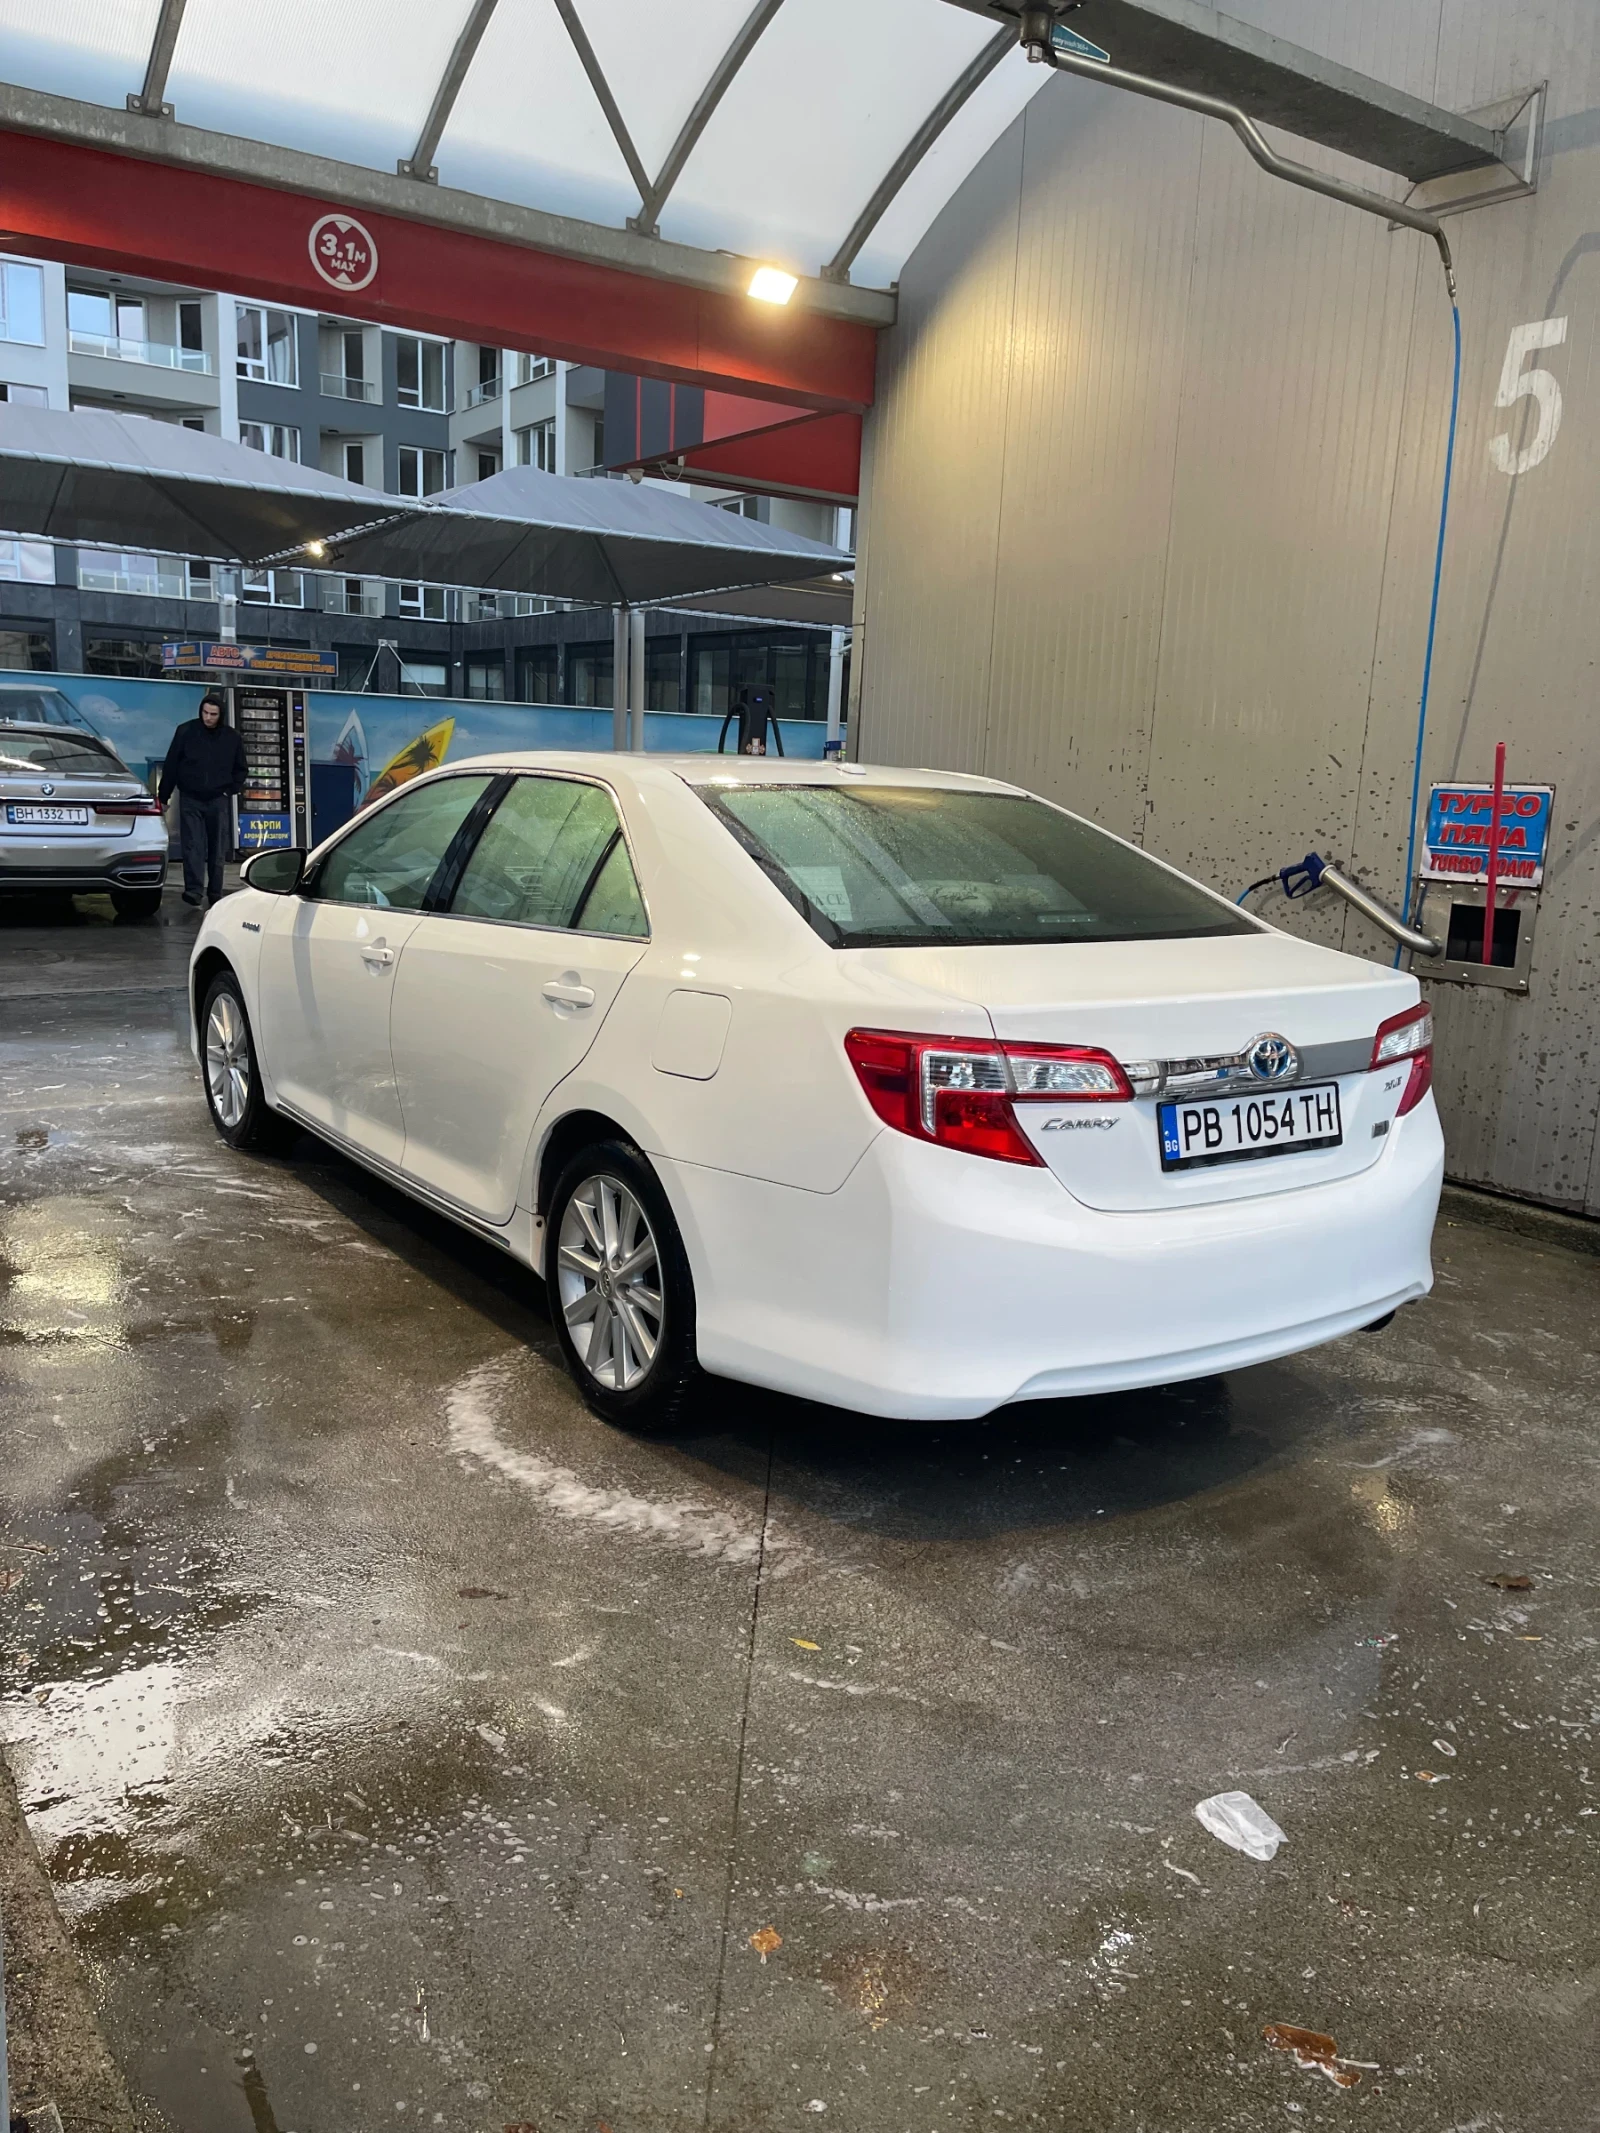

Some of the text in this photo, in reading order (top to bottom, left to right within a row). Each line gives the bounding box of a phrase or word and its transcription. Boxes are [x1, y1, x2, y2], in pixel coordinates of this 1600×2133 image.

[331, 258, 356, 273] MAX
[1489, 315, 1568, 475] 5
[15, 807, 83, 821] BH 1332 TT
[1438, 793, 1541, 817] ТУРБО
[250, 820, 282, 830] КЪРПИ
[1430, 853, 1483, 875] TURBO
[1182, 1106, 1224, 1152] PB
[1231, 1096, 1296, 1144] 1054
[1299, 1092, 1335, 1134] TH
[1164, 1138, 1179, 1153] BG
